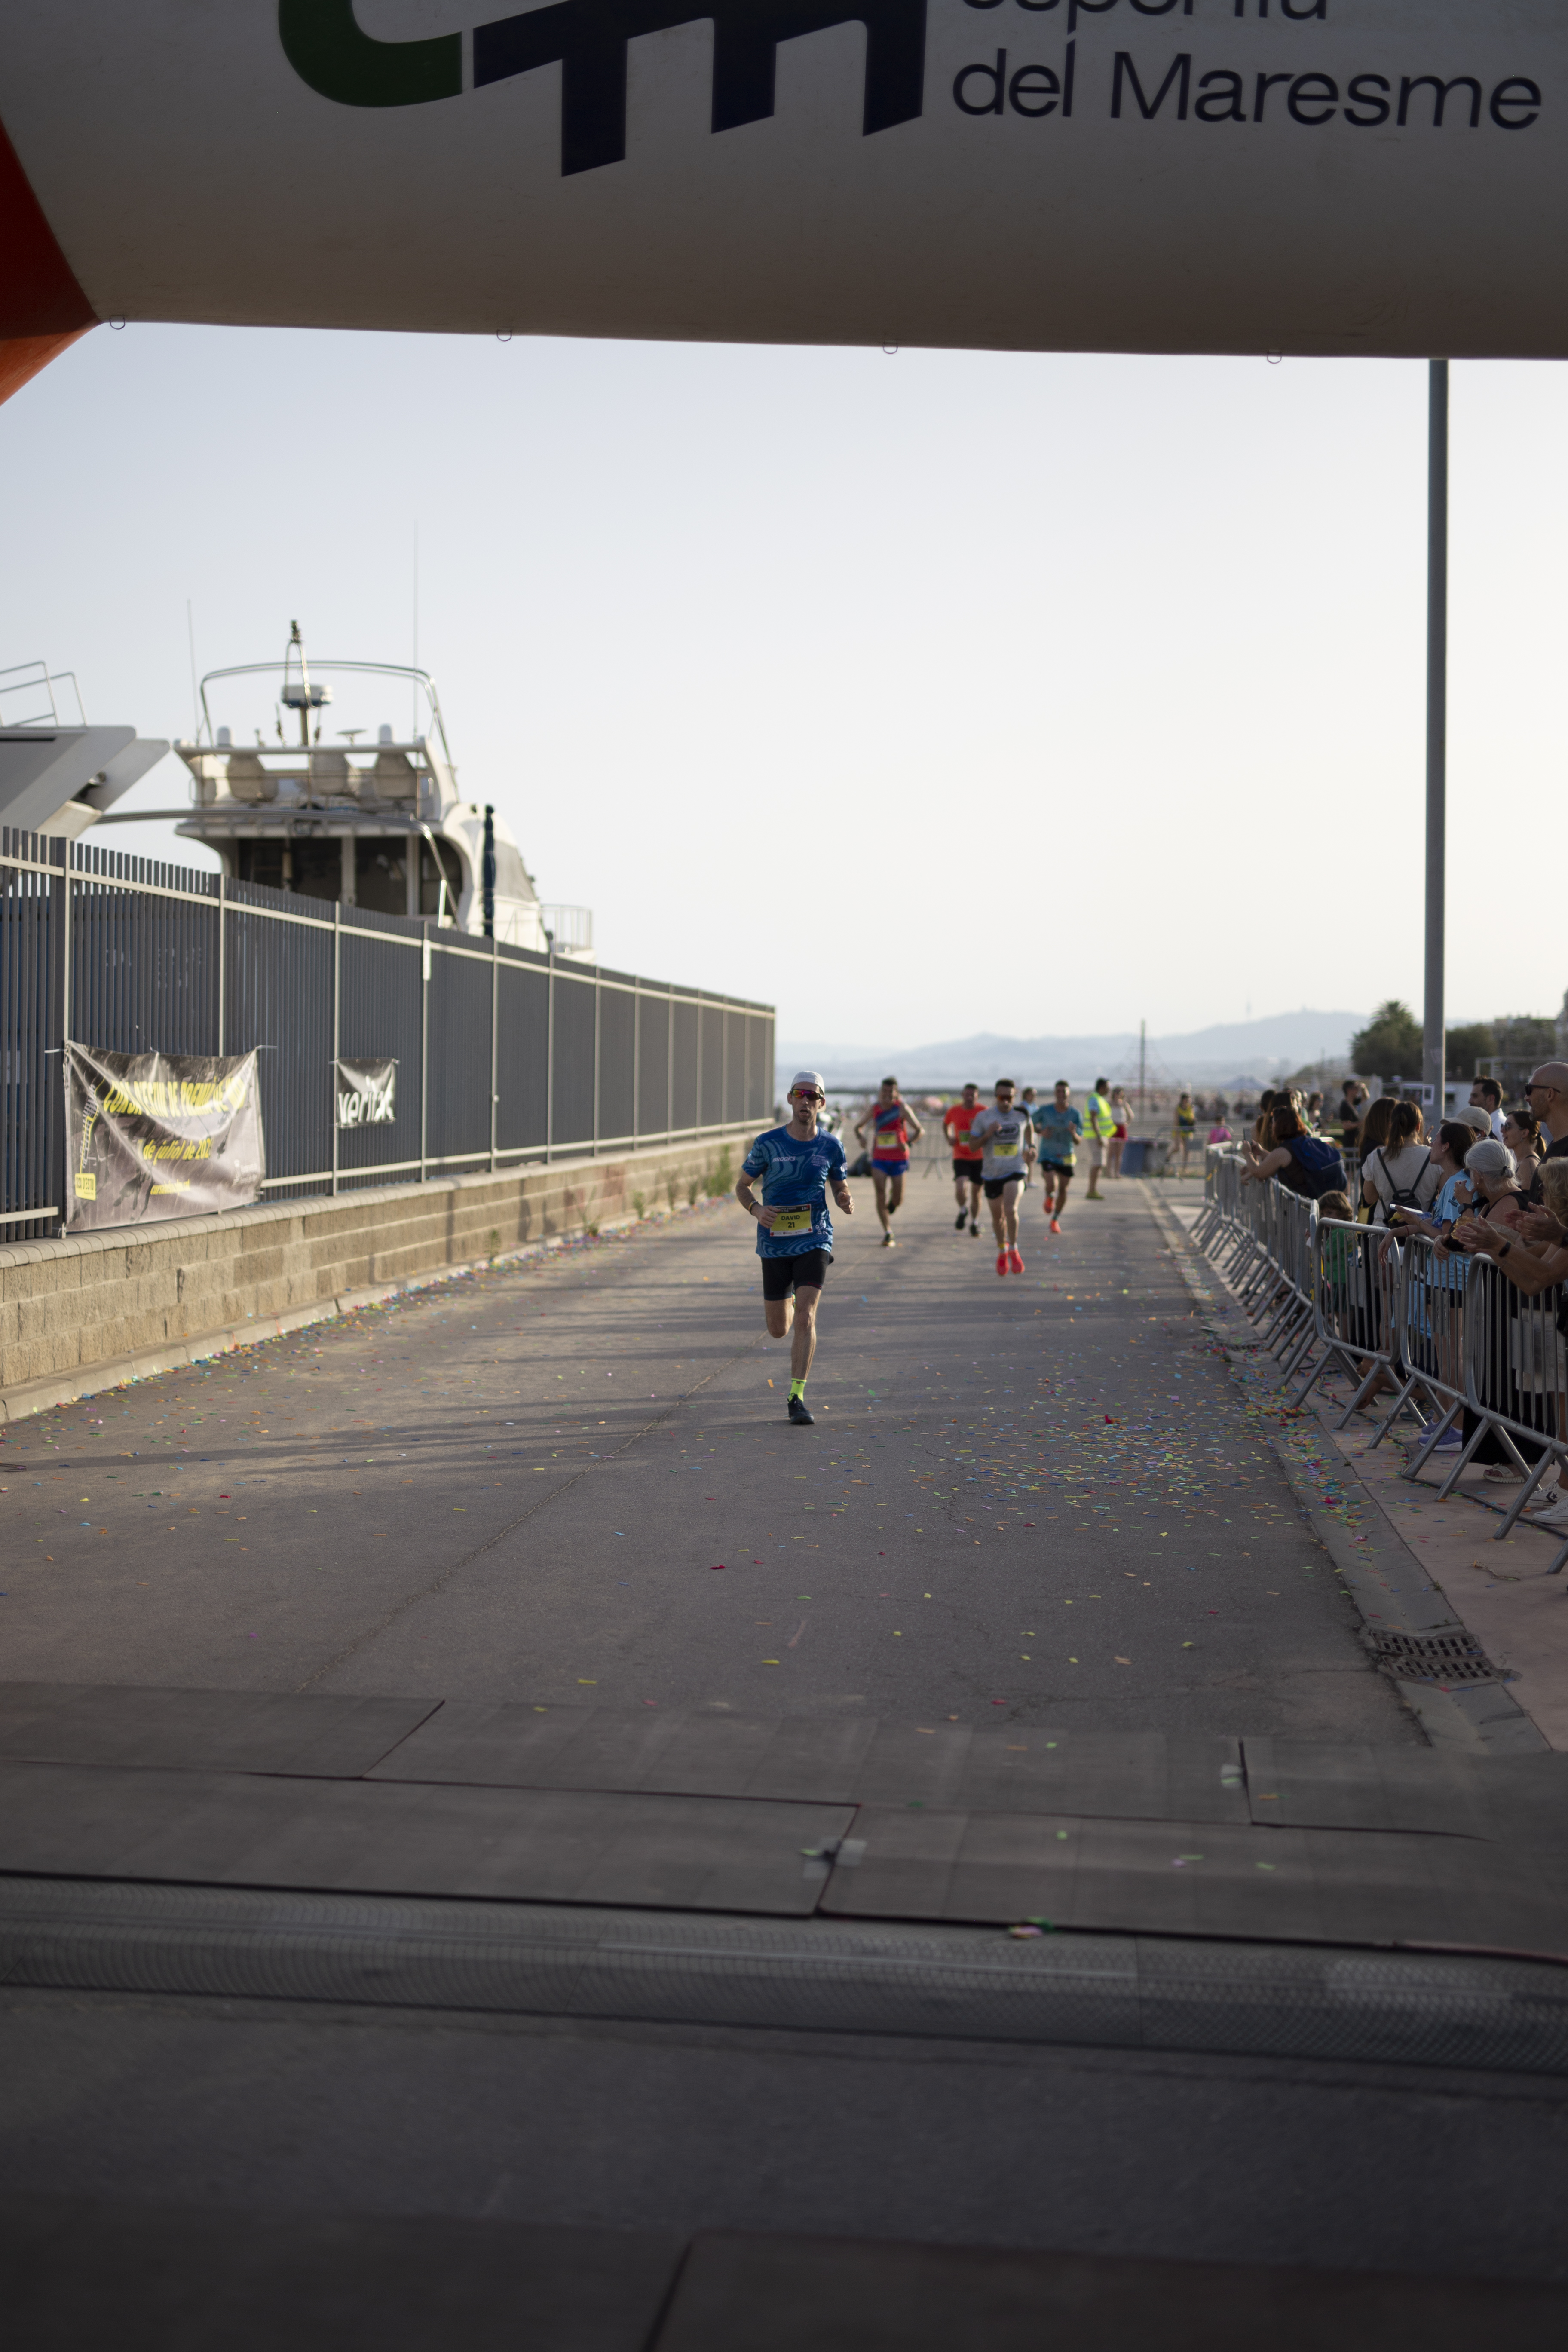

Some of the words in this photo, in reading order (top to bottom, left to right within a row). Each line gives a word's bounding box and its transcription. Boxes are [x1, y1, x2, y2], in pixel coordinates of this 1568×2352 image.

[952, 39, 1075, 117] del
[1111, 51, 1542, 129] Maresme
[153, 1139, 186, 1165] juliol
[183, 1139, 196, 1160] de
[195, 1137, 211, 1160] 202
